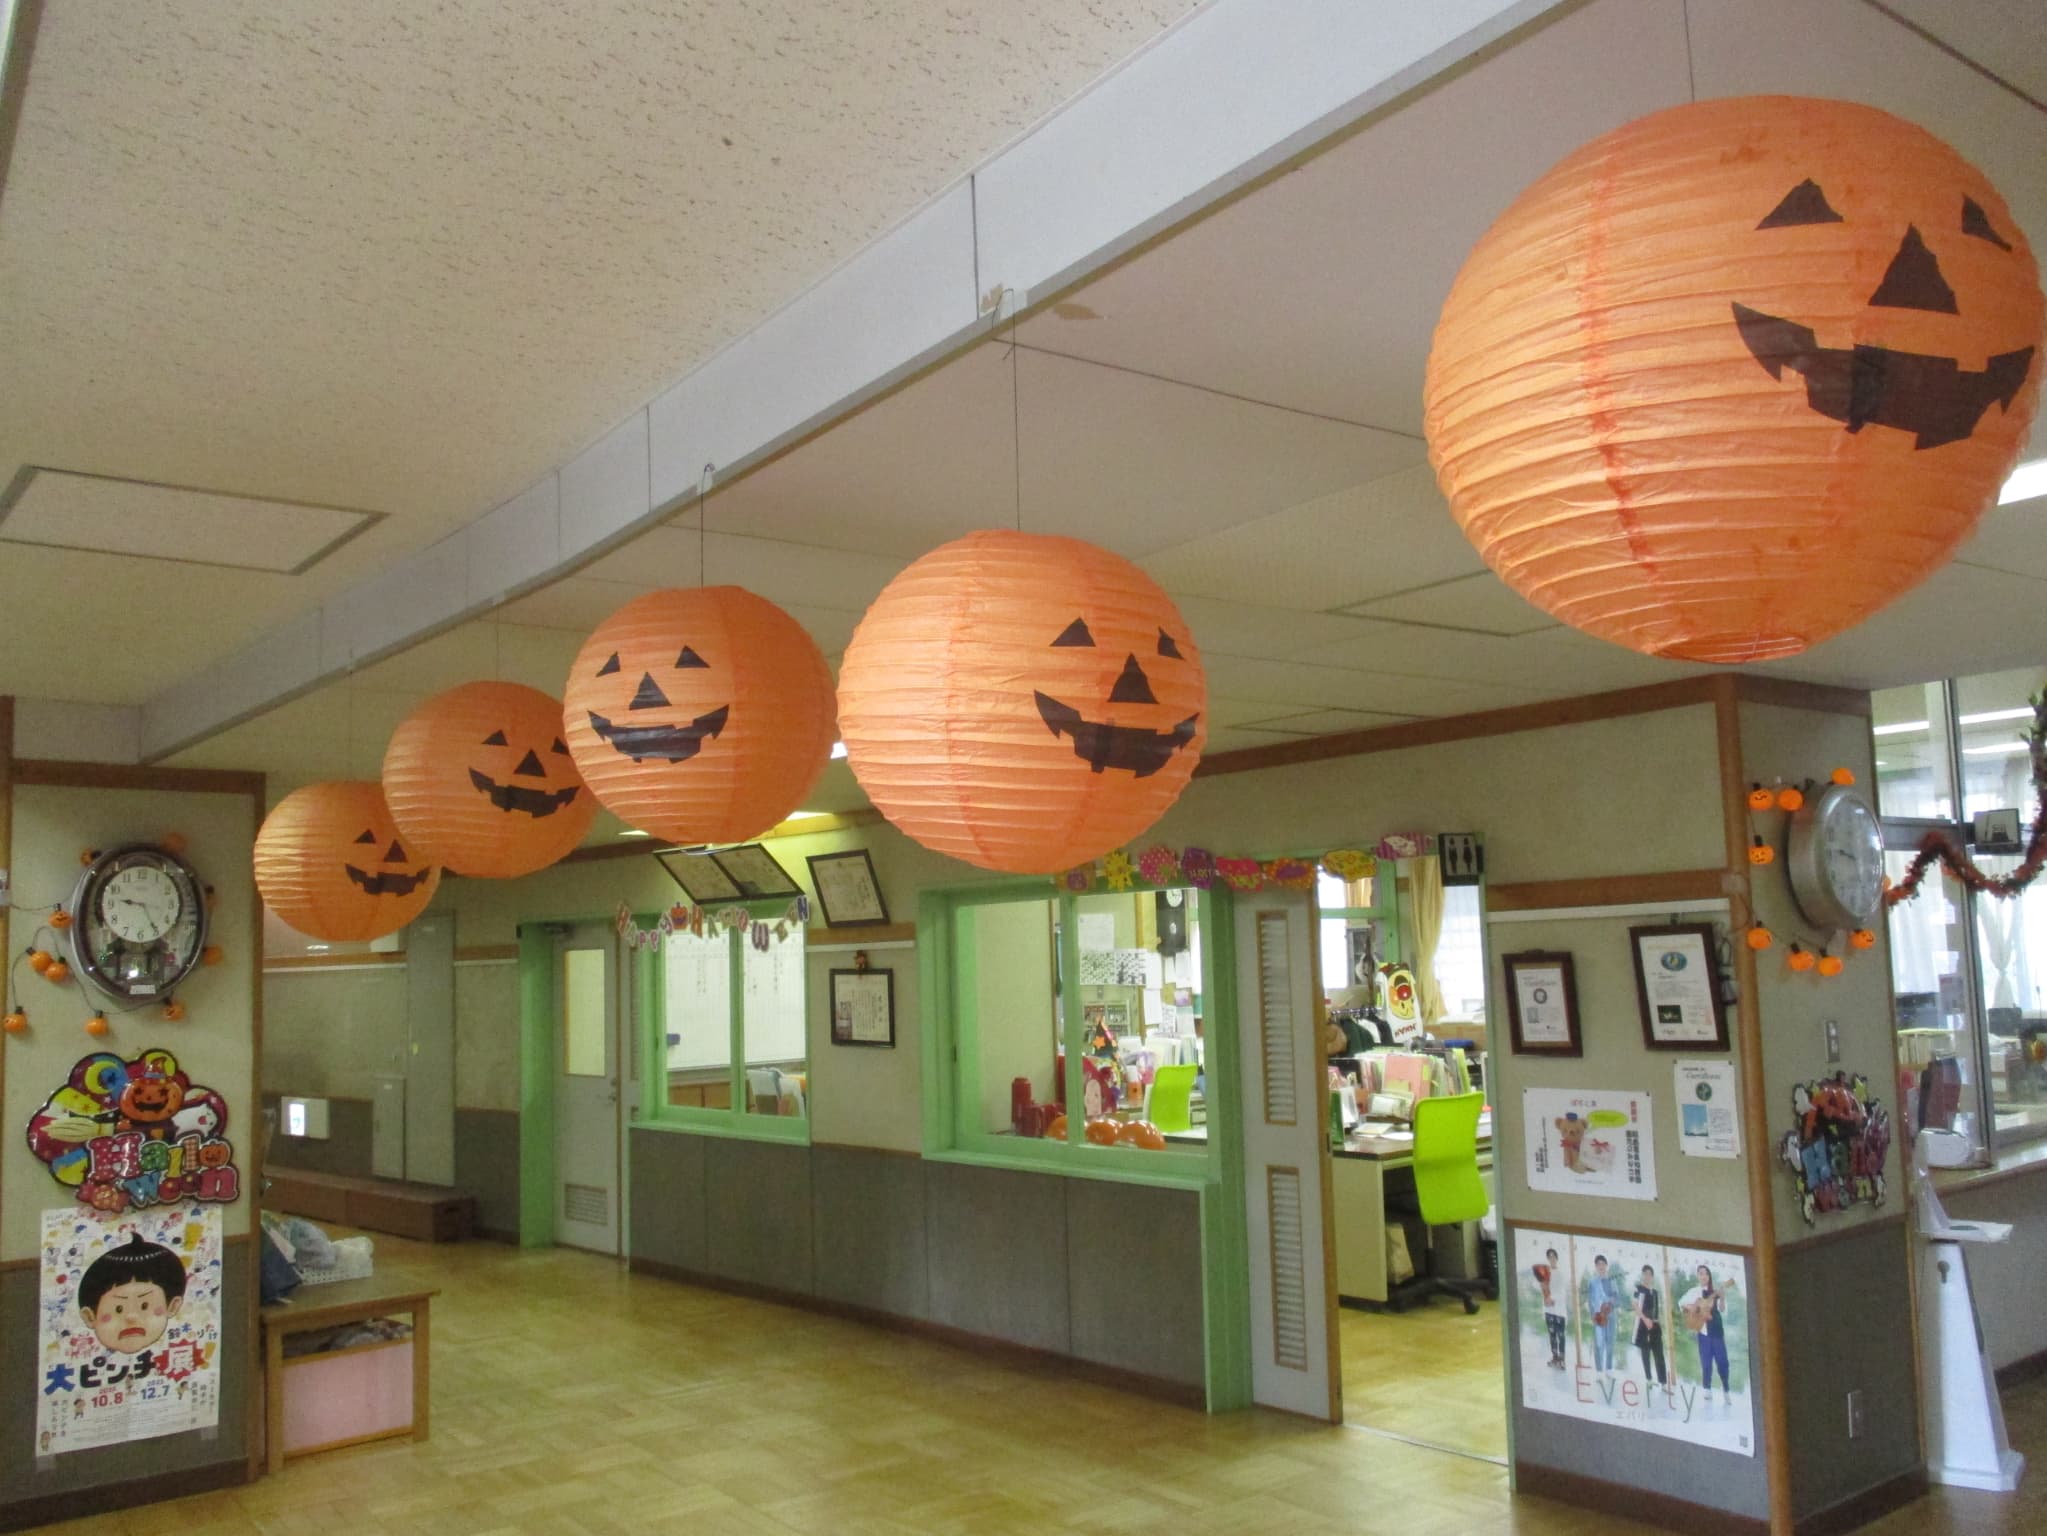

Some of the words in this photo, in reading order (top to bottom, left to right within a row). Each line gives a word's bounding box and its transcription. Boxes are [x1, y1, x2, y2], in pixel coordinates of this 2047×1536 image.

[111, 914, 118, 925] 8
[123, 926, 129, 937] 7
[137, 930, 145, 940] 6
[141, 1385, 170, 1400] 12.7
[91, 1392, 124, 1408] 10.8
